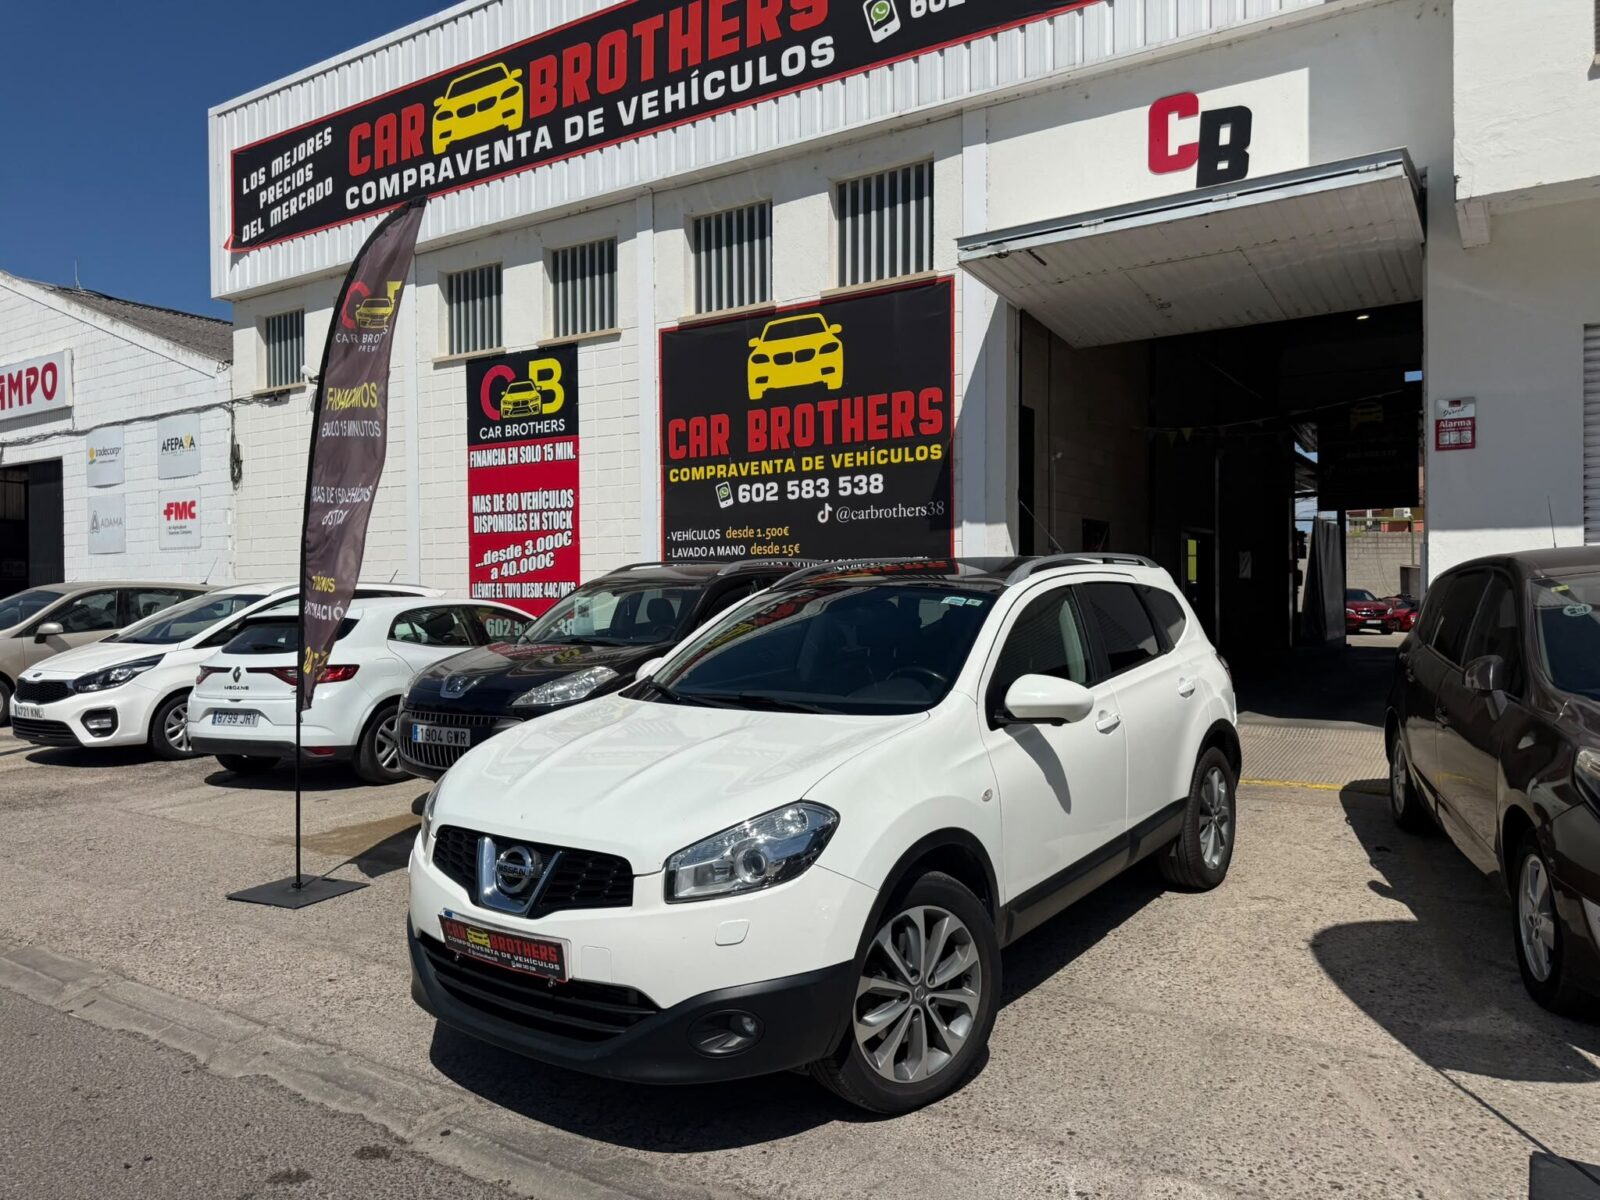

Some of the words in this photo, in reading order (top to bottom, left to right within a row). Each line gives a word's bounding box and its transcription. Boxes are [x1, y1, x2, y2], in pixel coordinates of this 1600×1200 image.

[348, 102, 426, 177] CAR
[529, 0, 828, 119] BROTHERS
[345, 130, 552, 211] COMPRAVENTA
[564, 107, 604, 144] DE
[617, 36, 836, 126] VEHÍCULOS
[1148, 91, 1253, 189] CB
[242, 168, 266, 195] LOS
[271, 127, 333, 176] MEJORES
[259, 163, 314, 209] PRECIOS
[242, 219, 264, 243] DEL
[270, 177, 334, 228] MERCADO
[335, 333, 359, 344] CAR
[479, 424, 502, 440] CAR
[505, 418, 566, 438] BROTHERS
[668, 413, 730, 459] CAR
[747, 387, 944, 453] BROTHERS
[1440, 420, 1472, 428] Alarma
[470, 448, 507, 468] FINANCIA
[507, 446, 518, 463] EN
[519, 444, 542, 462] SOLO
[543, 443, 553, 461] 15
[555, 441, 576, 460] MIN.
[669, 458, 796, 483] COMPRAVENTA
[802, 455, 824, 472] DE
[831, 444, 943, 469] VEHÍCULOS
[472, 494, 492, 514] MAS
[493, 493, 505, 512] DE
[506, 492, 519, 511] 80
[520, 486, 574, 509] VEHÍCULOS
[737, 483, 779, 503] 602
[786, 478, 830, 500] 583
[838, 473, 884, 496] 538
[101, 517, 123, 528] ADAMA
[163, 499, 196, 521] FMC
[473, 513, 528, 534] DISPONIBLES
[529, 512, 540, 529] EN
[541, 510, 573, 530] STOCK
[836, 500, 945, 522] @carbrothers38
[524, 530, 573, 555] 3.000€
[671, 528, 721, 541] VEHÍCULOS
[725, 525, 754, 539] desde
[756, 526, 789, 540] 1.500€
[672, 547, 708, 558] LAVADO
[708, 546, 716, 557] A
[717, 545, 746, 556] MANO
[750, 542, 779, 555] desde
[782, 544, 800, 557] 15€
[490, 567, 499, 580] a
[500, 552, 555, 576] 40.000€
[472, 581, 496, 599] LLÉVATE
[496, 583, 503, 599] EL
[504, 583, 521, 599] TUYO
[522, 582, 543, 598] DESDE
[485, 618, 511, 637] 602
[216, 712, 239, 725] 8799
[240, 712, 257, 726] JRY
[420, 728, 443, 743] 1904
[446, 730, 467, 745] GWR
[447, 935, 500, 958] COMPRAVENTA
[501, 951, 512, 961] DE
[513, 954, 561, 971] VEHÍCULOS
[489, 933, 558, 963] BROTHERS
